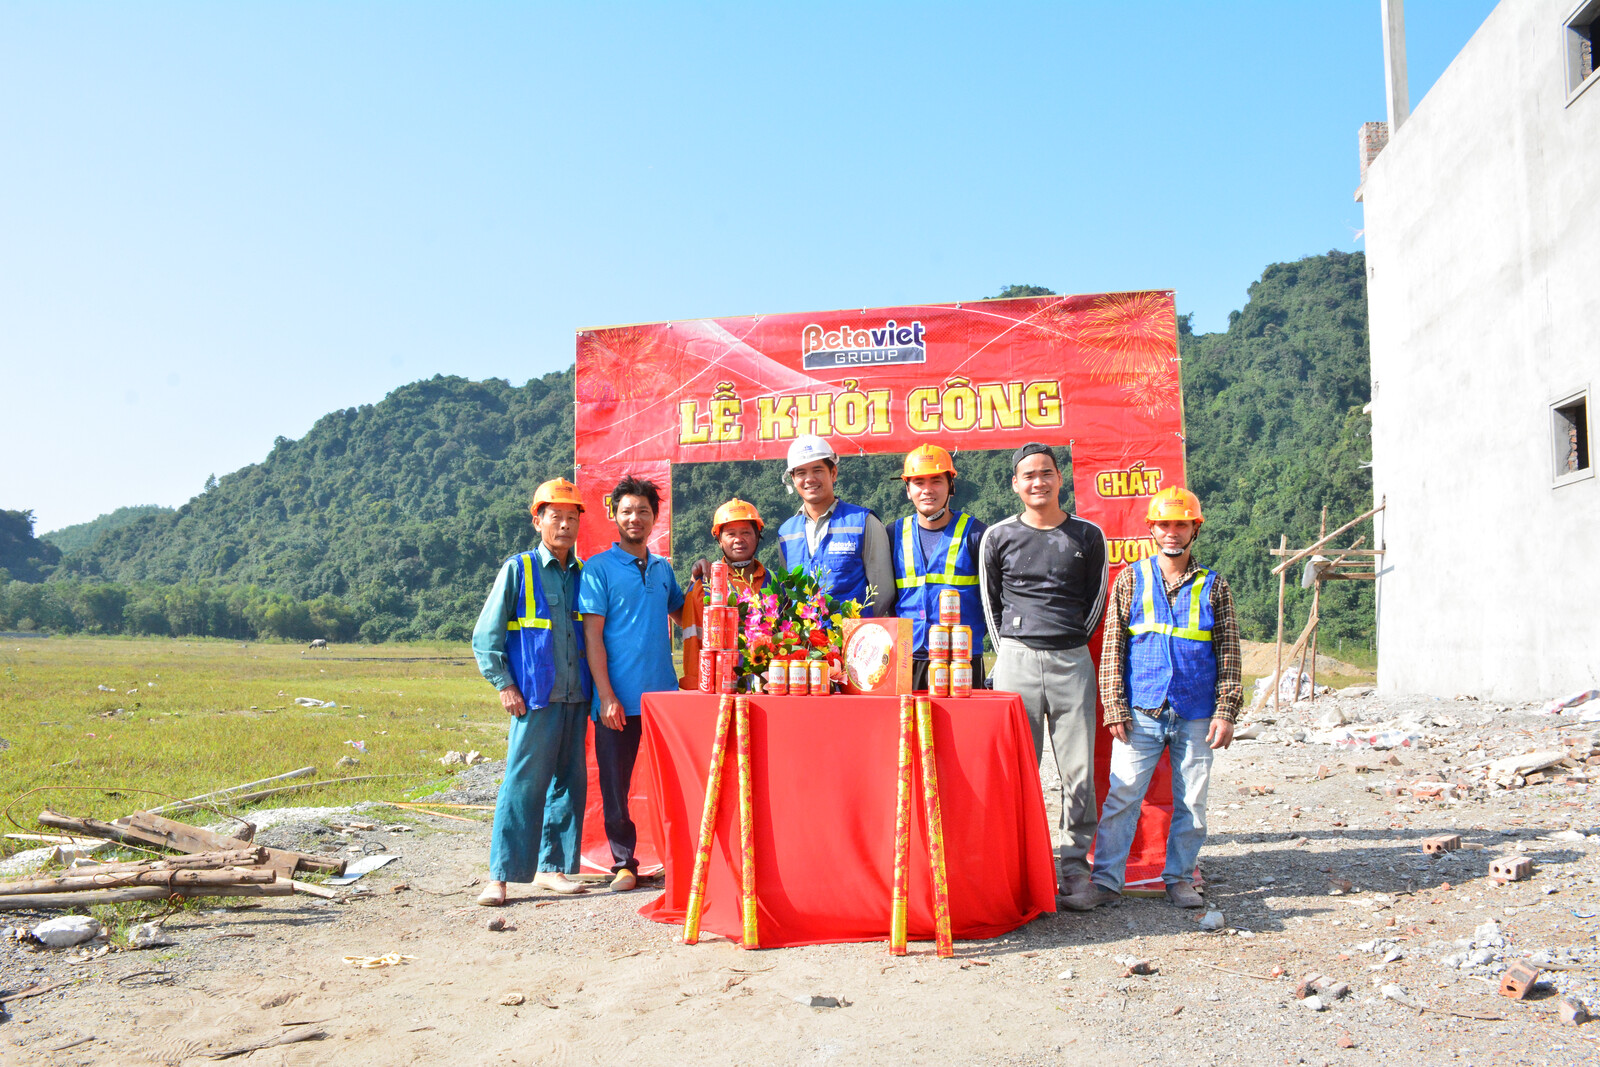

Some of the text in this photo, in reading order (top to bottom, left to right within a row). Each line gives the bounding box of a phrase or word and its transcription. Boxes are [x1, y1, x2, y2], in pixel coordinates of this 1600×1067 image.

[803, 320, 925, 356] Betaviet
[835, 349, 898, 364] GROUP
[678, 376, 1063, 445] LỄ KHỞI CÔNG
[1096, 461, 1162, 497] CHẤT
